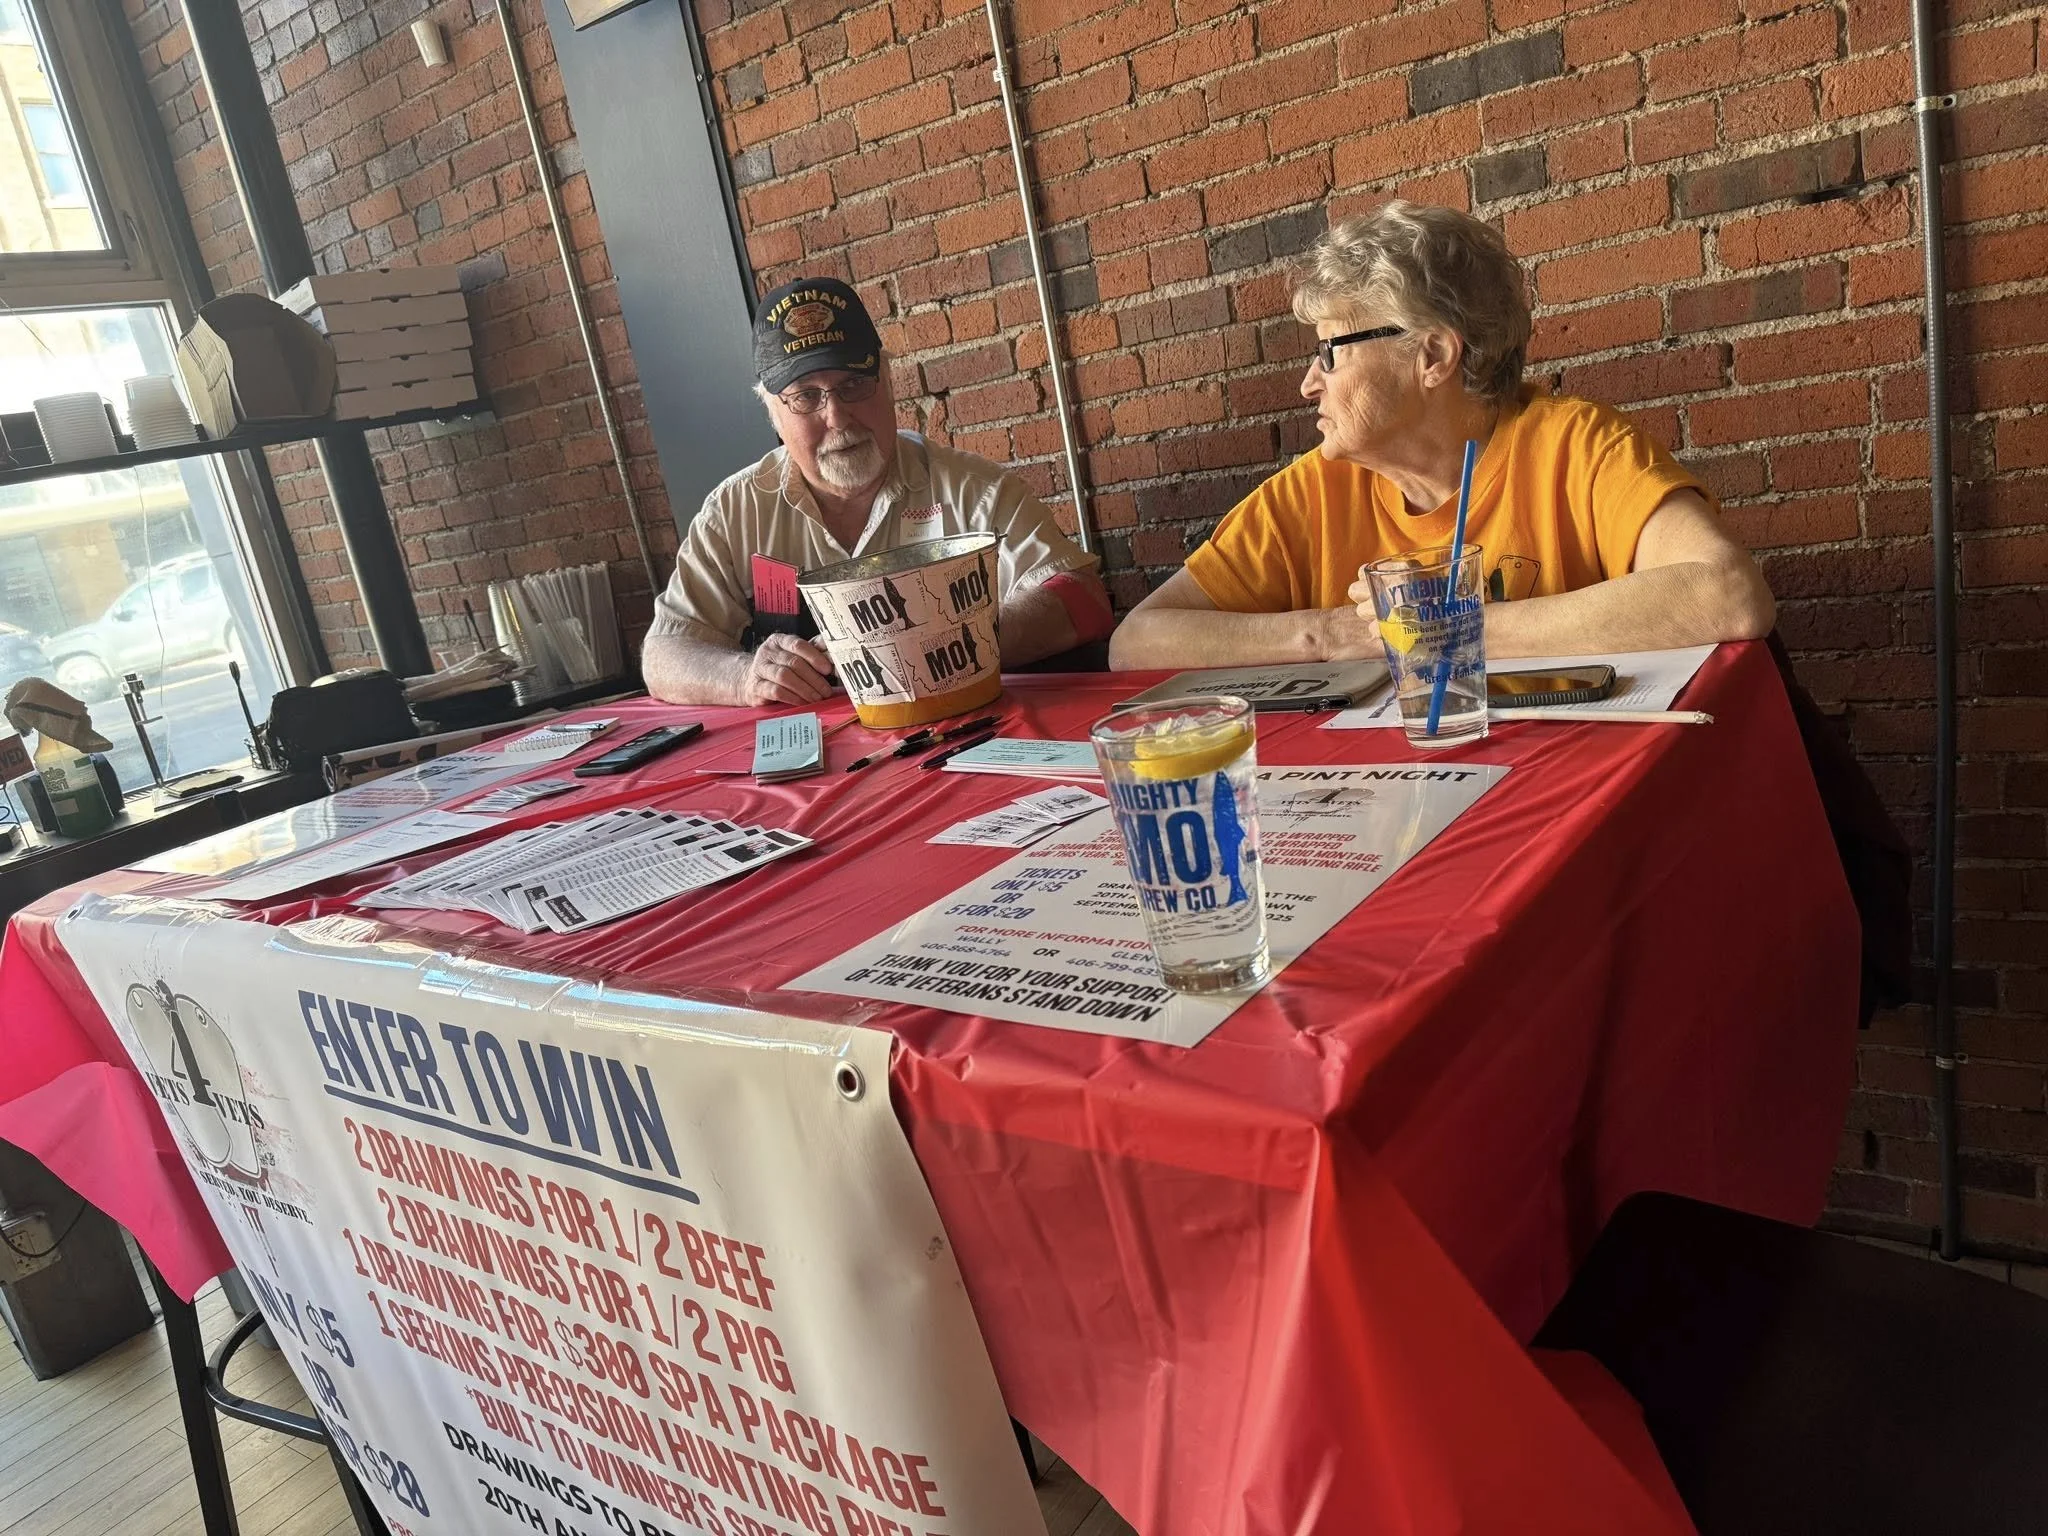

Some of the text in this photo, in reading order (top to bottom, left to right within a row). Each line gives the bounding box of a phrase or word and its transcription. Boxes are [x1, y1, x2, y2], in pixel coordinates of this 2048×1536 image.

[766, 289, 847, 323] VIETNAM
[783, 330, 845, 354] VETERAN
[949, 570, 982, 615] MO
[848, 594, 895, 634] MO
[1403, 627, 1418, 636] This
[1420, 625, 1438, 634] beer
[1425, 632, 1449, 644] expert
[1428, 645, 1438, 654] on
[925, 640, 967, 682] MO
[1186, 681, 1281, 693] Interstate
[1279, 771, 1361, 781] PINT
[1362, 770, 1478, 782] NIGHT
[1287, 832, 1357, 842] WRAPPED
[1053, 843, 1104, 851] DRAWING
[1118, 810, 1212, 887] MO
[1273, 840, 1343, 850] WRAPPED
[1053, 850, 1080, 858] THIS
[1265, 848, 1384, 863] STUDIO MONTAGE
[1281, 858, 1343, 869] HUNTING
[1341, 861, 1384, 873] RIFLE
[1015, 867, 1088, 880] TICKETS
[991, 879, 1069, 893] ONLY $5
[992, 892, 1024, 904] OR
[1092, 891, 1129, 899] 20TH
[1285, 892, 1318, 903] THE
[944, 904, 1035, 920] 5 FOR $20
[1073, 899, 1140, 910] SEPTEMB
[1266, 902, 1297, 911] WN
[1092, 909, 1120, 917] NEED
[1266, 913, 1295, 922] 025
[954, 925, 989, 934] FOR
[987, 928, 1037, 939] MORE
[957, 935, 1007, 945] WALLY
[919, 942, 1012, 957] 406-868-4764
[1032, 947, 1061, 957] OR
[1111, 951, 1155, 962] GLEN
[1066, 957, 1160, 977] 406-799-63
[873, 953, 1177, 1004] THANK YOU FOR YOUR SUPPORT
[844, 968, 1163, 1023] OF THE VETERANS STAND DOWN
[145, 1008, 266, 1130] VETS 4 VETS
[298, 989, 682, 1179] ENTER TO WIN
[199, 1170, 240, 1198] SERVED,
[238, 1186, 262, 1205] YOU
[344, 1116, 776, 1313] 2 DRAWINGS FOR 1/2 BEEF
[377, 1187, 797, 1395] 2 DRAWINGS FOR 1/2 PIG
[305, 1299, 356, 1368] $5
[342, 1227, 371, 1278] 1
[359, 1234, 500, 1335] DRAWING
[489, 1288, 561, 1362] FOR
[554, 1315, 651, 1400] $300
[648, 1351, 735, 1437] SPA
[727, 1382, 947, 1517] PACKAGE
[367, 1290, 839, 1536] 1 SEEKINS PRECISION HUNTING
[363, 1440, 431, 1518] $20
[441, 1420, 637, 1536] DRAWINGS TO
[540, 1419, 584, 1471] TO
[577, 1437, 727, 1536] WINNER'S
[477, 1478, 550, 1536] 20TH
